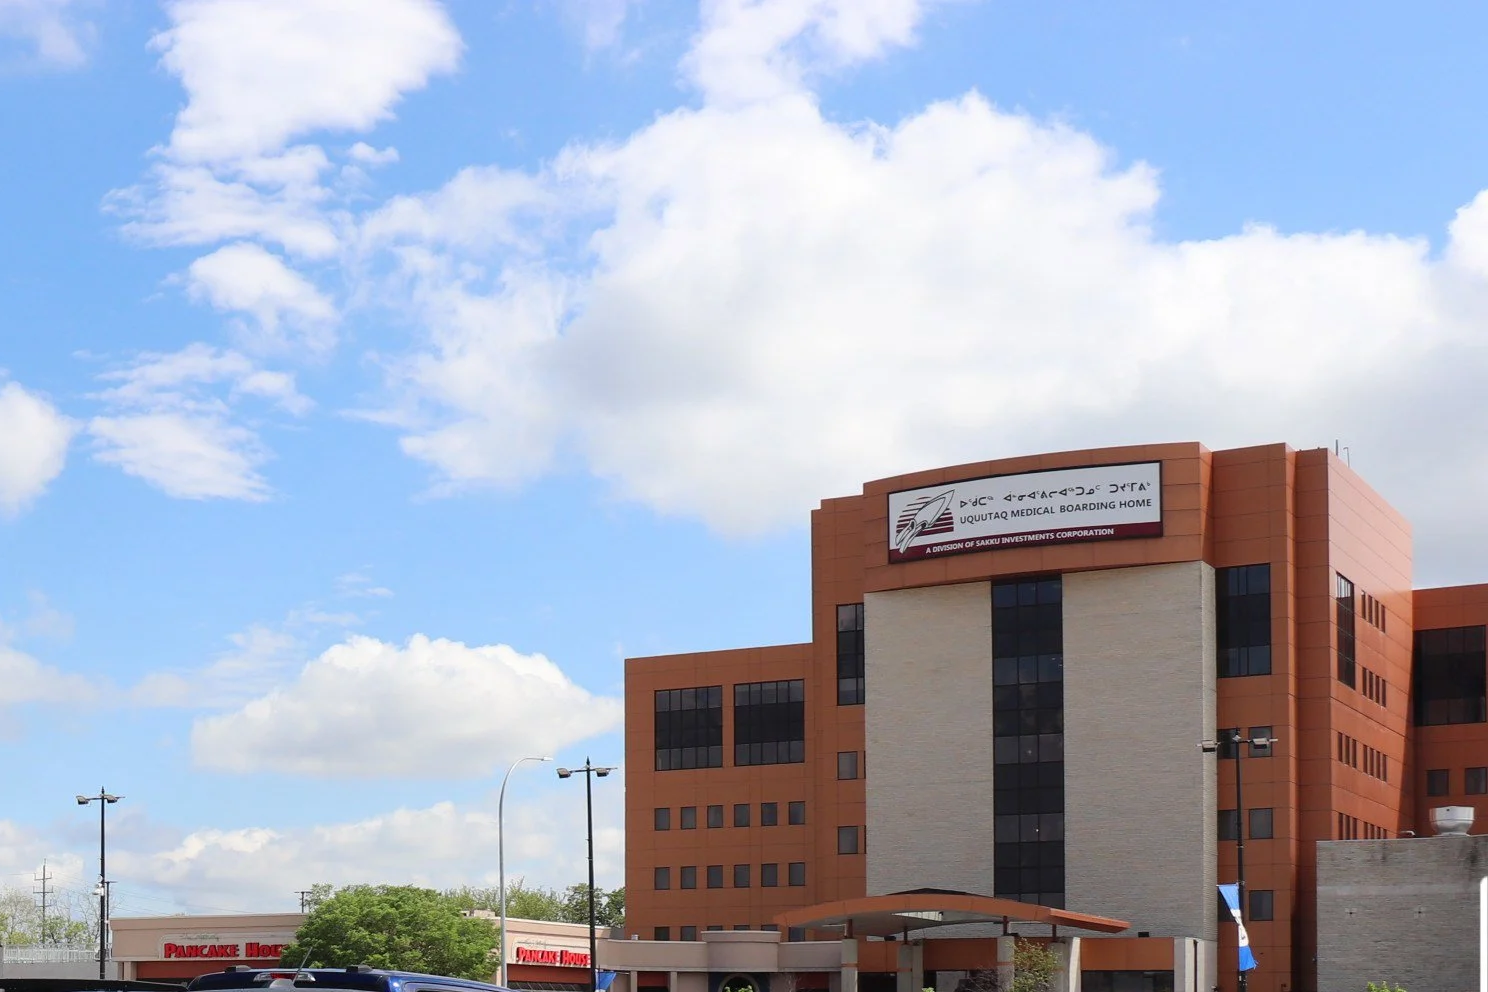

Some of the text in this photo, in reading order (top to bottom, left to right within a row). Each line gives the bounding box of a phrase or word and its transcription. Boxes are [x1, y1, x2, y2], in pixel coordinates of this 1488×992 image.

[960, 499, 1152, 524] UQUUTAQ MEDICAL BOARDING HOME
[932, 542, 964, 553] DIVISION
[976, 538, 1000, 547] SAKKU
[1002, 533, 1055, 544] INVESTMENTS
[1056, 528, 1114, 539] CORPORATION
[164, 942, 288, 958] PANCAKE HOU
[516, 946, 560, 963] PANCAKE
